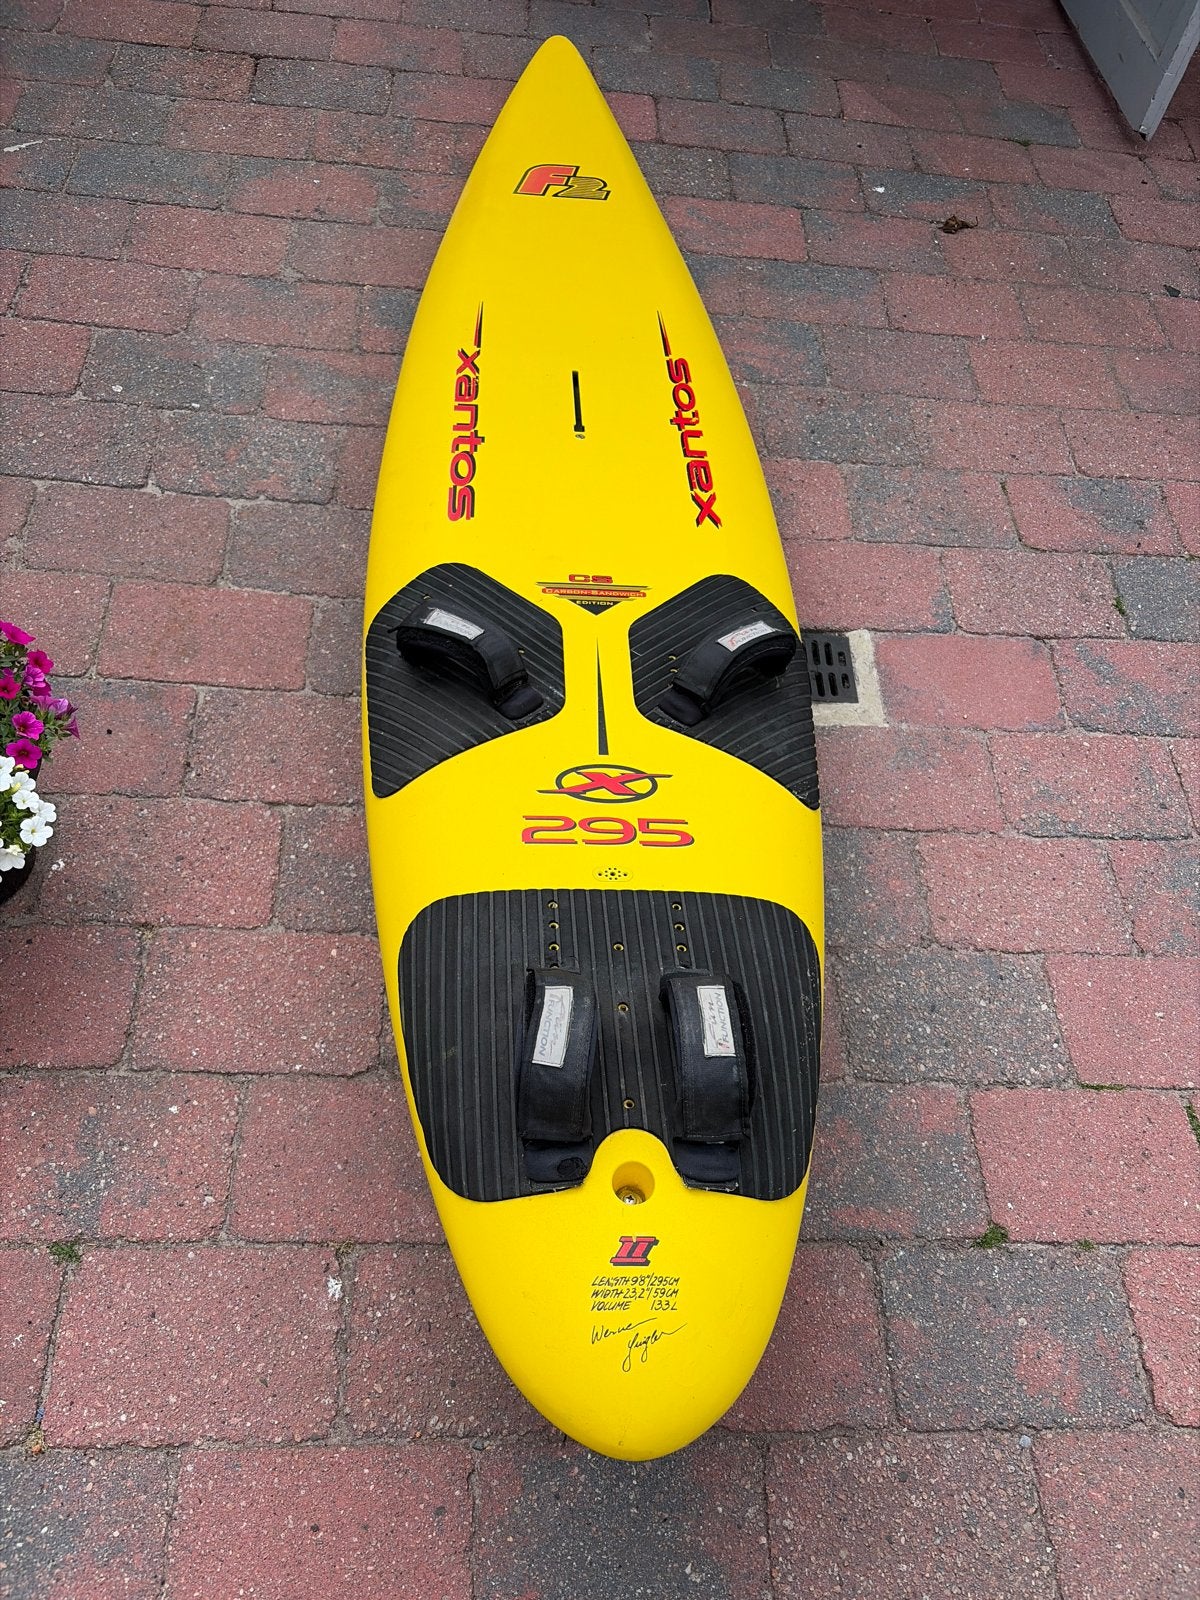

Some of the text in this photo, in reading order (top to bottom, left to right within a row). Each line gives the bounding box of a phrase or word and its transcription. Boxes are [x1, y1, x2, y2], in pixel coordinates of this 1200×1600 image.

[512, 163, 611, 201] F2
[447, 347, 485, 522] xantos
[664, 356, 723, 530] xantos
[568, 573, 614, 584] CS
[521, 815, 695, 847] 295
[538, 999, 555, 1057] FUNCTION
[714, 992, 730, 1043] FUNCTION
[590, 1300, 632, 1312] VOLUME
